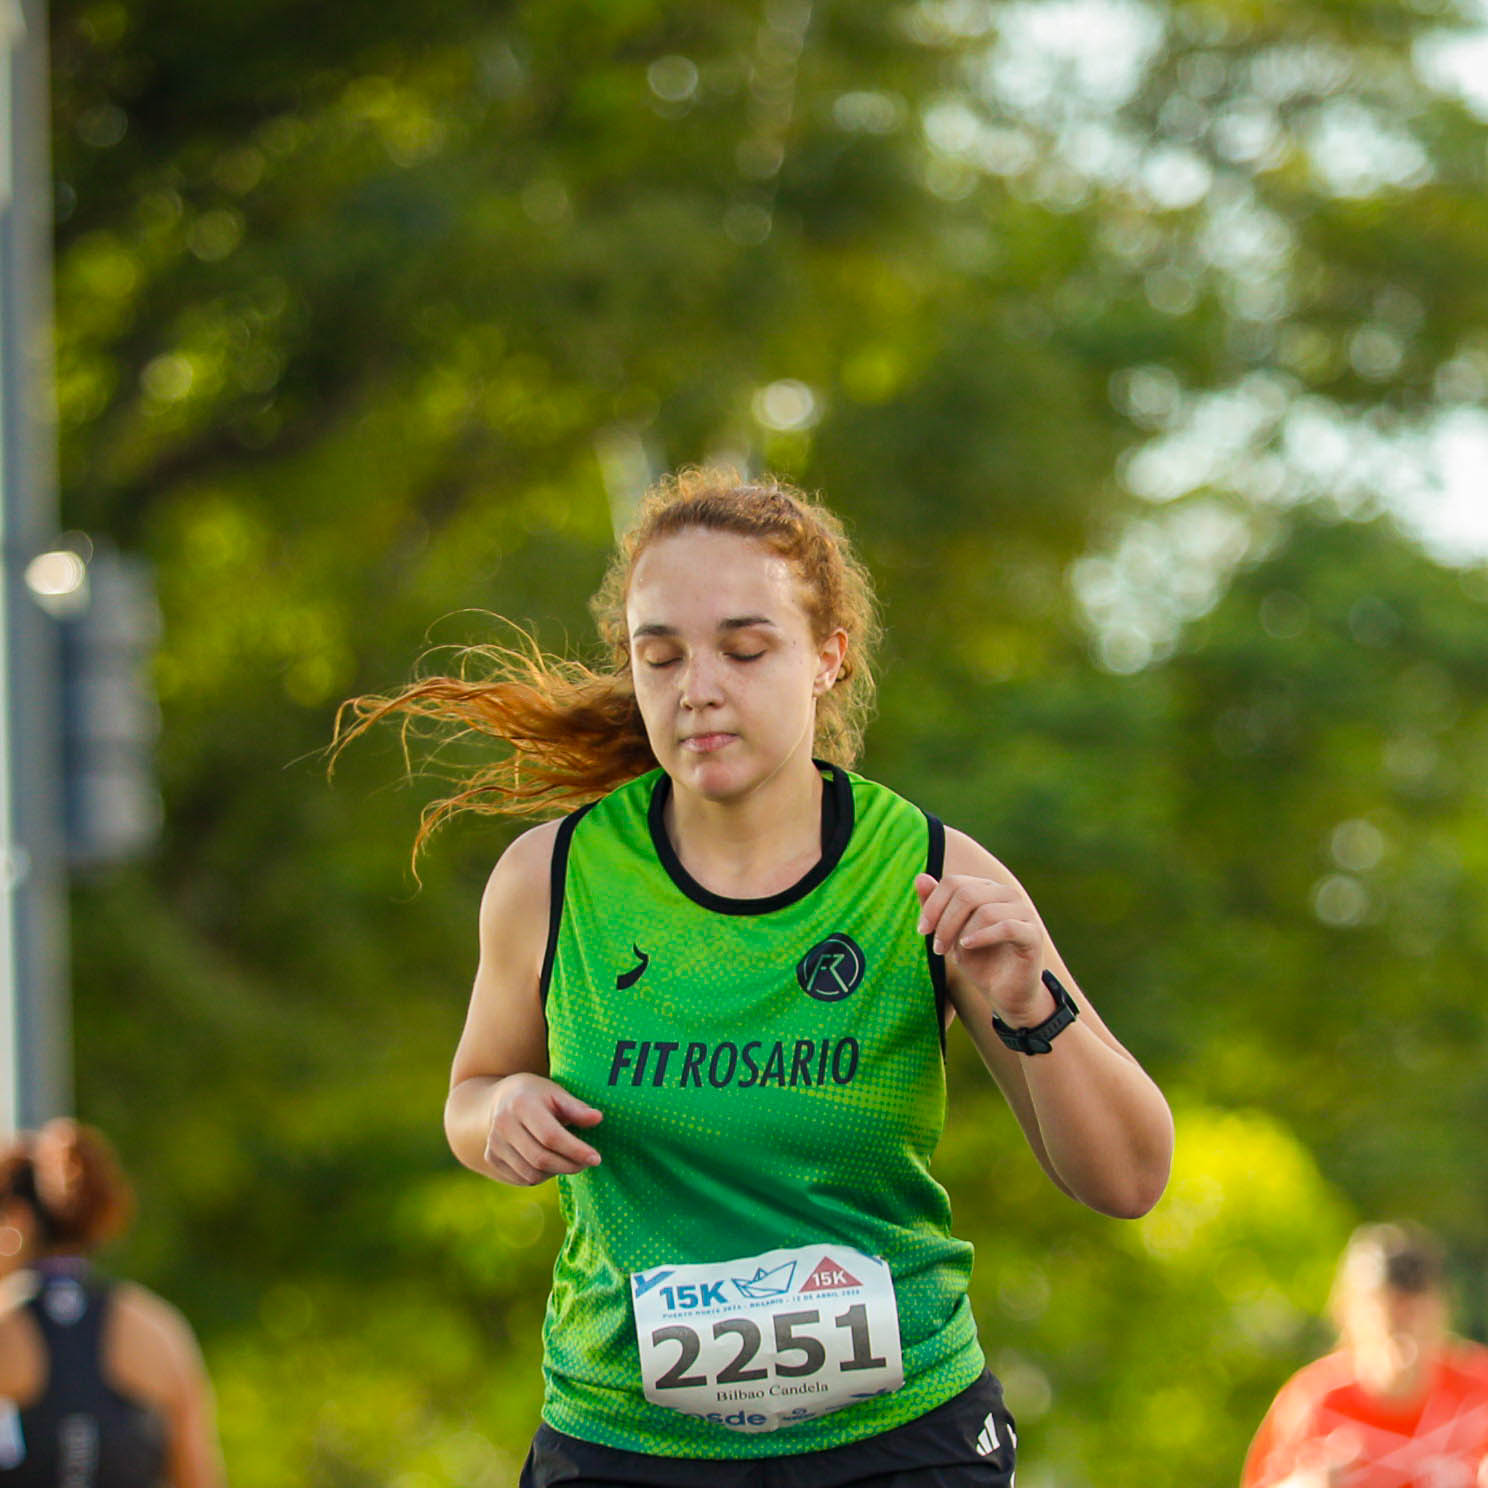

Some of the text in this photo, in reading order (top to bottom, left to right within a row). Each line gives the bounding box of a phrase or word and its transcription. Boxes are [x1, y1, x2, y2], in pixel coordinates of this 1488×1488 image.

[812, 1270, 848, 1287] 15K
[659, 1280, 728, 1311] 15K
[651, 1303, 887, 1390] 2251
[716, 1381, 829, 1401] Bilbao Candela
